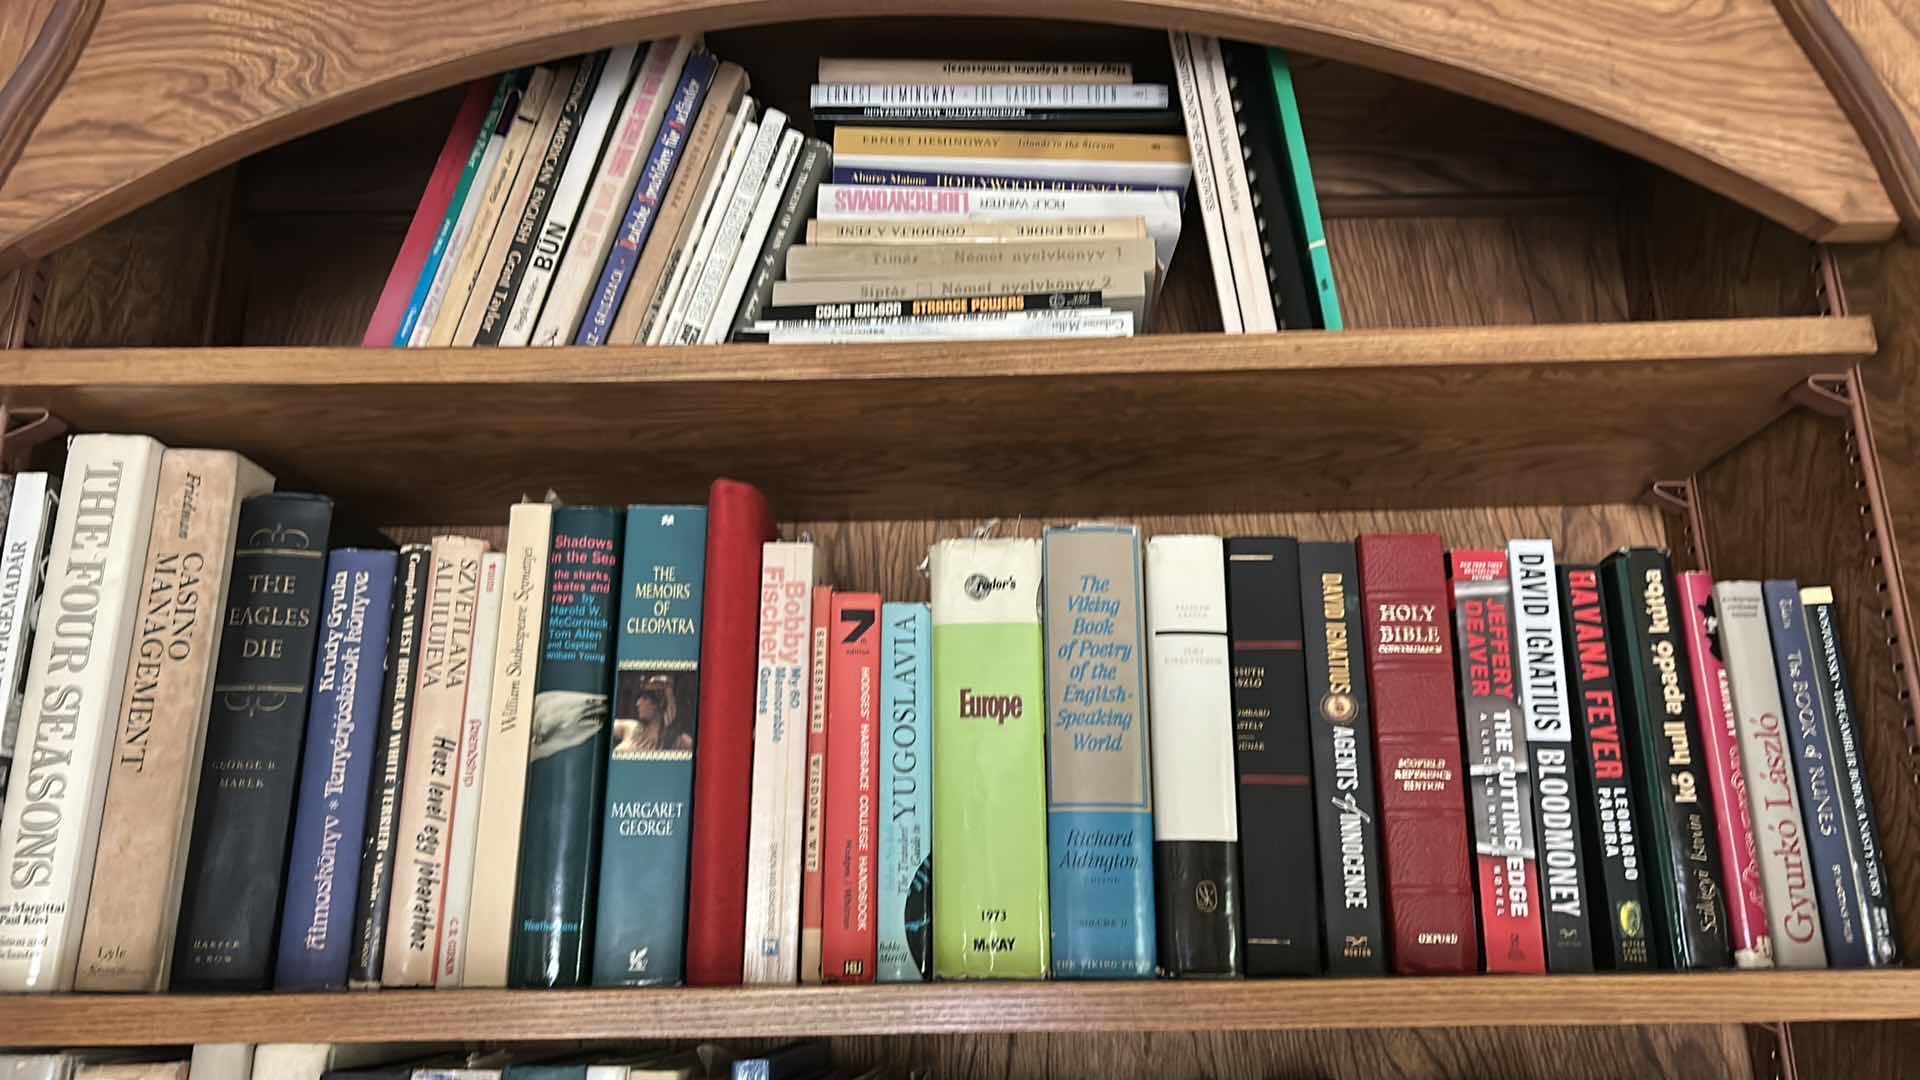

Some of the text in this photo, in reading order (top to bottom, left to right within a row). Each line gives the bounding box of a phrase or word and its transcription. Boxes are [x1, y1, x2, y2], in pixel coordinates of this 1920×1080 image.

[826, 85, 871, 104] ERNEST
[883, 85, 955, 104] HEMINGWAY
[1006, 85, 1051, 104] GARDEN
[1087, 85, 1118, 104] EDEN
[539, 117, 570, 183] AMERICAN
[863, 136, 999, 148] ERNEST HEMINGWAY
[516, 187, 545, 243] ENGLISH
[533, 222, 565, 270] BÜN
[479, 250, 521, 331] Grant Taylor
[1102, 276, 1111, 288] 2
[816, 303, 851, 319] COLIN
[854, 301, 902, 317] WILSON
[912, 298, 967, 316] STRANGE
[971, 295, 1024, 314] POWERS
[72, 462, 122, 548] THE
[552, 551, 616, 565] in the Sea
[556, 534, 613, 550] Shadows
[248, 575, 296, 594] THE
[553, 582, 610, 593] skates and
[555, 570, 569, 580] the
[635, 584, 691, 600] MEMOIRS
[653, 566, 675, 582] THE
[1080, 575, 1110, 592] The
[48, 560, 104, 672] FOUR
[168, 552, 203, 660] CASINO
[229, 607, 310, 627] EAGLES
[343, 572, 369, 642] könyve
[550, 605, 585, 617] Harold
[552, 594, 595, 605] rays by
[654, 601, 671, 616] OF
[758, 566, 786, 663] Fischer
[1068, 595, 1121, 617] Viking
[1380, 604, 1435, 622] HOLY
[319, 571, 347, 690] Krúdy Gyula
[423, 559, 452, 687] ALLILUJEVA
[446, 559, 476, 687] SZVETLANA
[550, 630, 602, 640] Tom Allen
[626, 618, 695, 635] CLEOPATRA
[778, 581, 805, 663] Bobby
[1073, 618, 1114, 636] Book
[1322, 573, 1350, 693] DAVID IGNATIUS
[1380, 625, 1441, 643] BIBLE
[242, 638, 283, 659] DIE
[1057, 640, 1132, 662] of Poetry
[1463, 601, 1490, 695] DEAVER
[1487, 597, 1512, 696] JEFFERY
[1518, 554, 1560, 729] DAVID IGNATIUS
[121, 555, 176, 770] MANAGEMENT
[500, 606, 528, 732] William Shakespeare
[788, 667, 801, 686] My
[813, 631, 824, 728] SHAKESPEARE
[1070, 661, 1117, 682] of the
[1569, 571, 1622, 777] HAVANA FEVER
[376, 553, 420, 850] Complete WEST HIGHLAND WHITE TERRIER
[758, 666, 771, 714] Games
[772, 667, 785, 741] Memorable
[1063, 684, 1133, 706] English-
[1645, 569, 1696, 802] kő hull apadó kútba
[892, 617, 916, 818] YUGOSLAVIA
[960, 688, 1023, 725] Europe
[1056, 707, 1132, 731] Speaking
[1074, 733, 1122, 752] World
[1787, 650, 1836, 835] The BOOK of RUNES
[11, 686, 79, 887] SEASONS
[220, 778, 265, 788] MAREK
[611, 801, 683, 818] MARGARET
[619, 820, 673, 836] GEORGE
[807, 757, 820, 867] WISDOM WIT
[857, 723, 869, 930] HARBRACE COLLEGE HANDBOOK
[1333, 726, 1366, 906] AGENTS INNOCENCE
[1492, 710, 1528, 917] THE CUTTING EDGE
[1598, 787, 1618, 856] PADURA
[1754, 712, 1815, 943] Gyurkó László
[415, 825, 439, 854] egy
[1065, 829, 1134, 848] Richard
[1538, 749, 1578, 913] BLOODMONEY
[1613, 787, 1637, 879] LEONARDO
[1057, 850, 1139, 873] Aldington
[1493, 865, 1504, 915] NOVEL
[1417, 933, 1458, 945] OXFORD
[1056, 960, 1116, 969] THE VIKING
